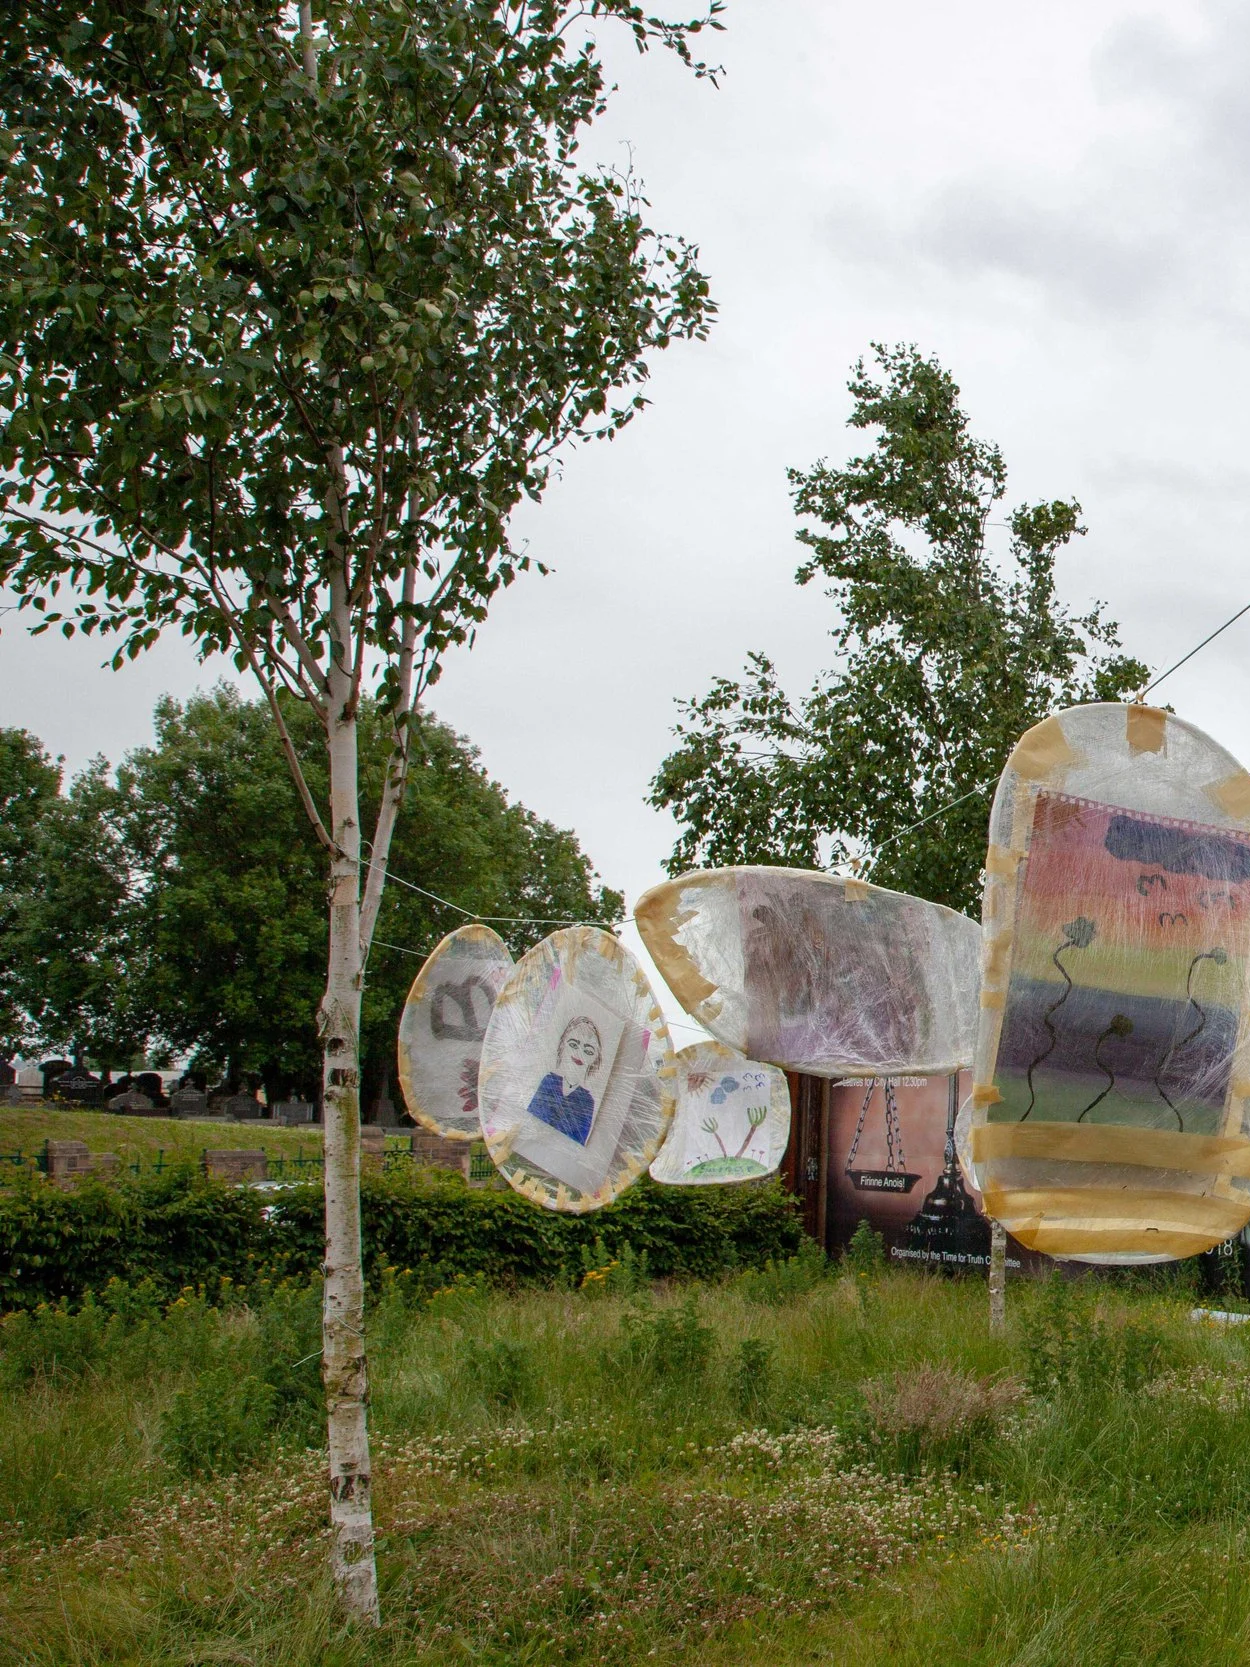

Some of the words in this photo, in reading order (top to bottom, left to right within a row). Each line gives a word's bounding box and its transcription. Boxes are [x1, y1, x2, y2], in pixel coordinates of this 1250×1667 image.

[890, 1246, 921, 1259] Organised
[921, 1250, 929, 1261] by
[930, 1250, 940, 1260] the
[941, 1251, 957, 1262] Time
[957, 1252, 967, 1263] for
[967, 1253, 984, 1265] Truth
[985, 1255, 1021, 1268] Cittee
